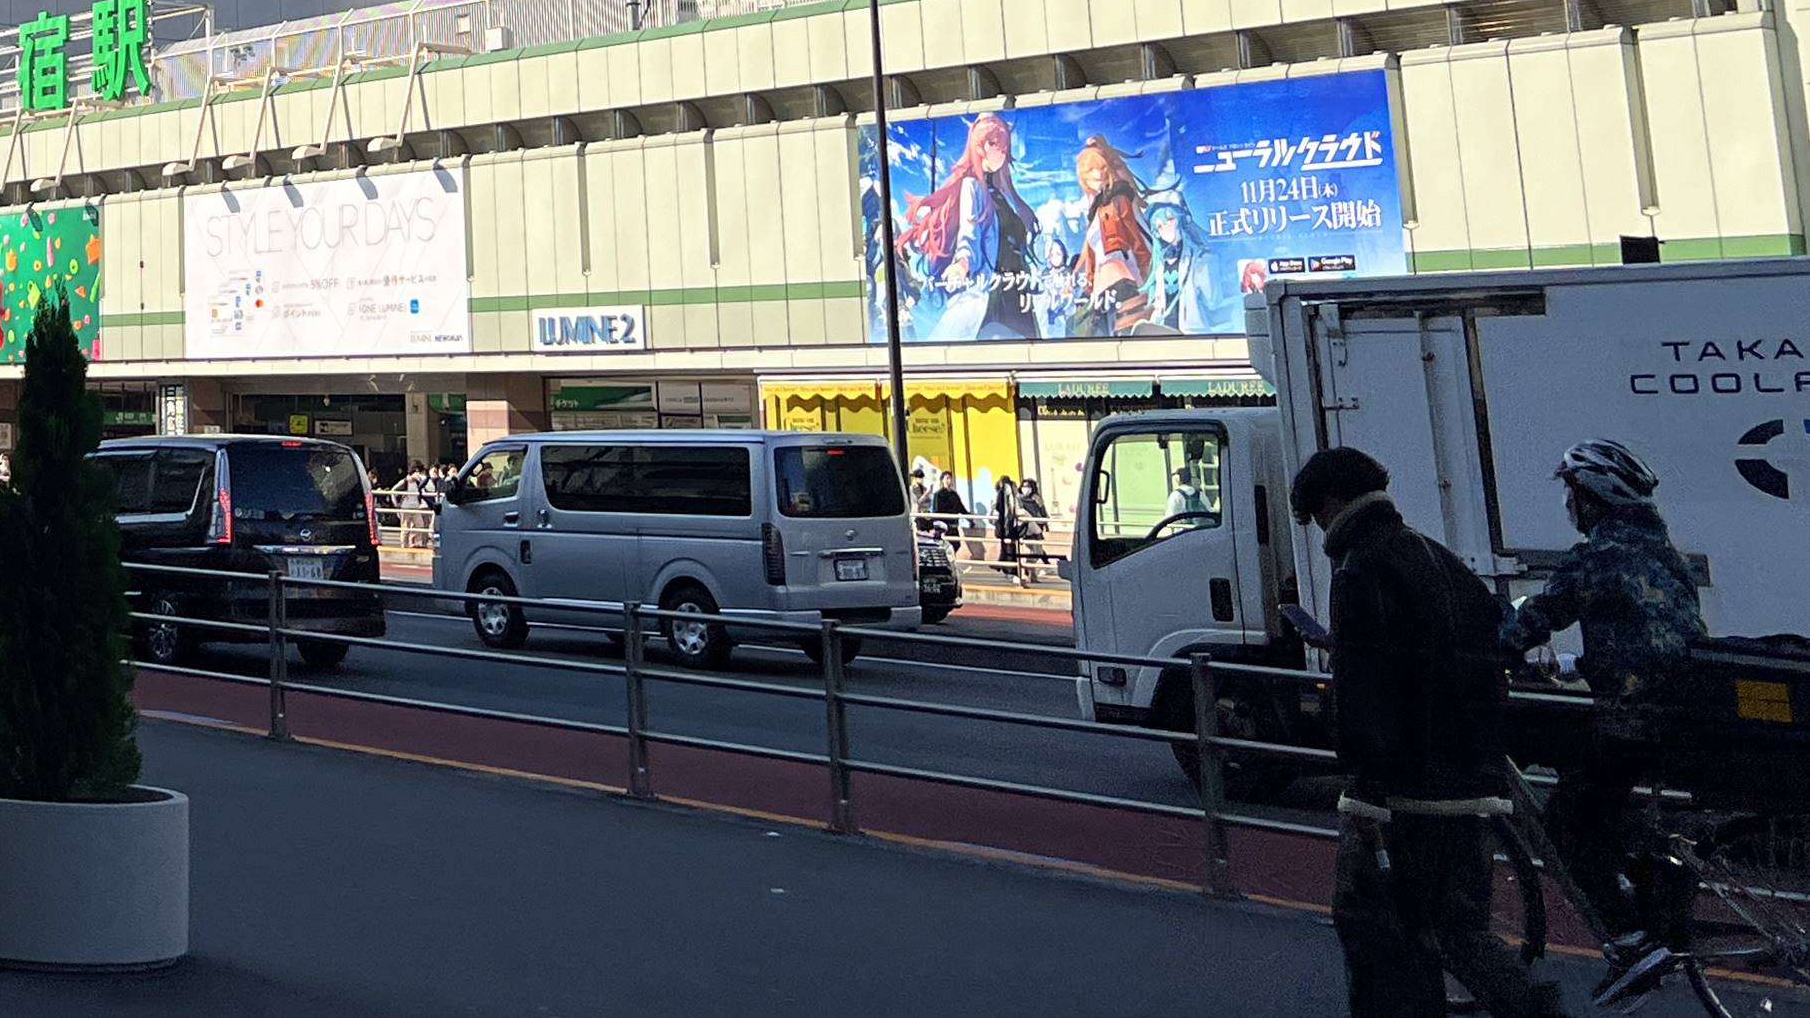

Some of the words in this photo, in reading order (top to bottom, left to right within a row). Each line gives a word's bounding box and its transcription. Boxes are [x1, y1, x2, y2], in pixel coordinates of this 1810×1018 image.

[1193, 130, 1384, 174] ニューラルクラウド
[1241, 175, 1339, 204] 11月24日(木)
[206, 209, 283, 258] STYLE
[286, 203, 360, 251] YOUR
[364, 196, 436, 247] DAYS
[1207, 198, 1382, 237] 正式リリース開始
[538, 315, 619, 346] LUMINE
[620, 313, 637, 345] 2
[1661, 337, 1805, 362] TAKA
